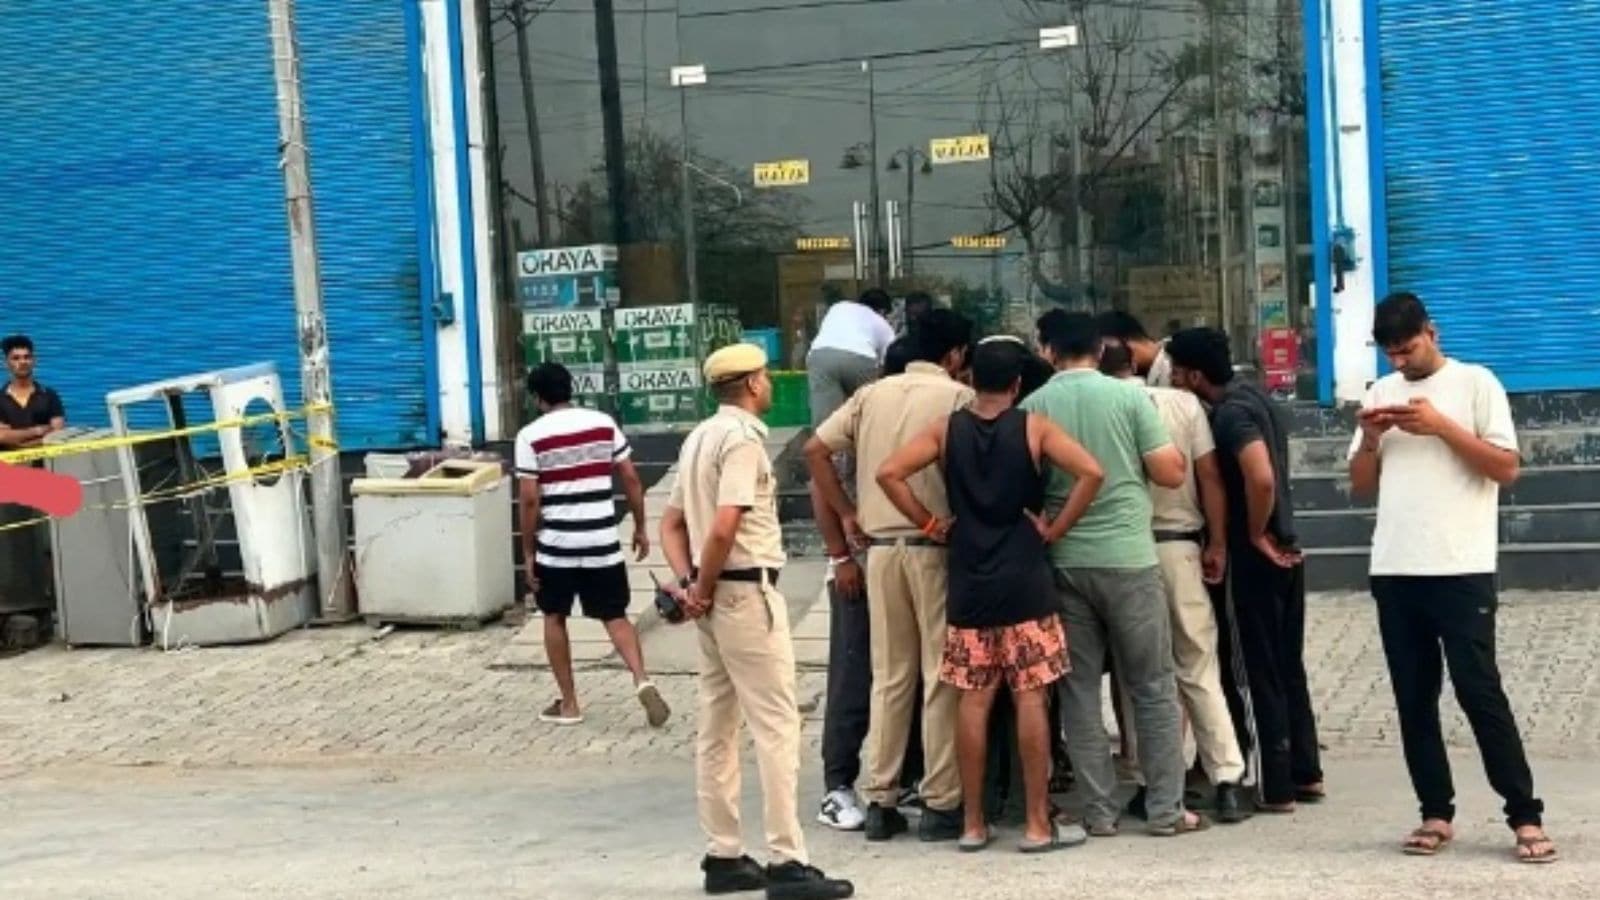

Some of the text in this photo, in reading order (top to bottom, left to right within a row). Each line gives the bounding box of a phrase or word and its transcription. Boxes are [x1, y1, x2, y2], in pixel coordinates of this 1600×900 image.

[522, 249, 599, 275] OKAYA
[532, 313, 594, 331] OKAYA
[624, 308, 688, 327] OKAYA
[627, 371, 693, 390] OKAYA
